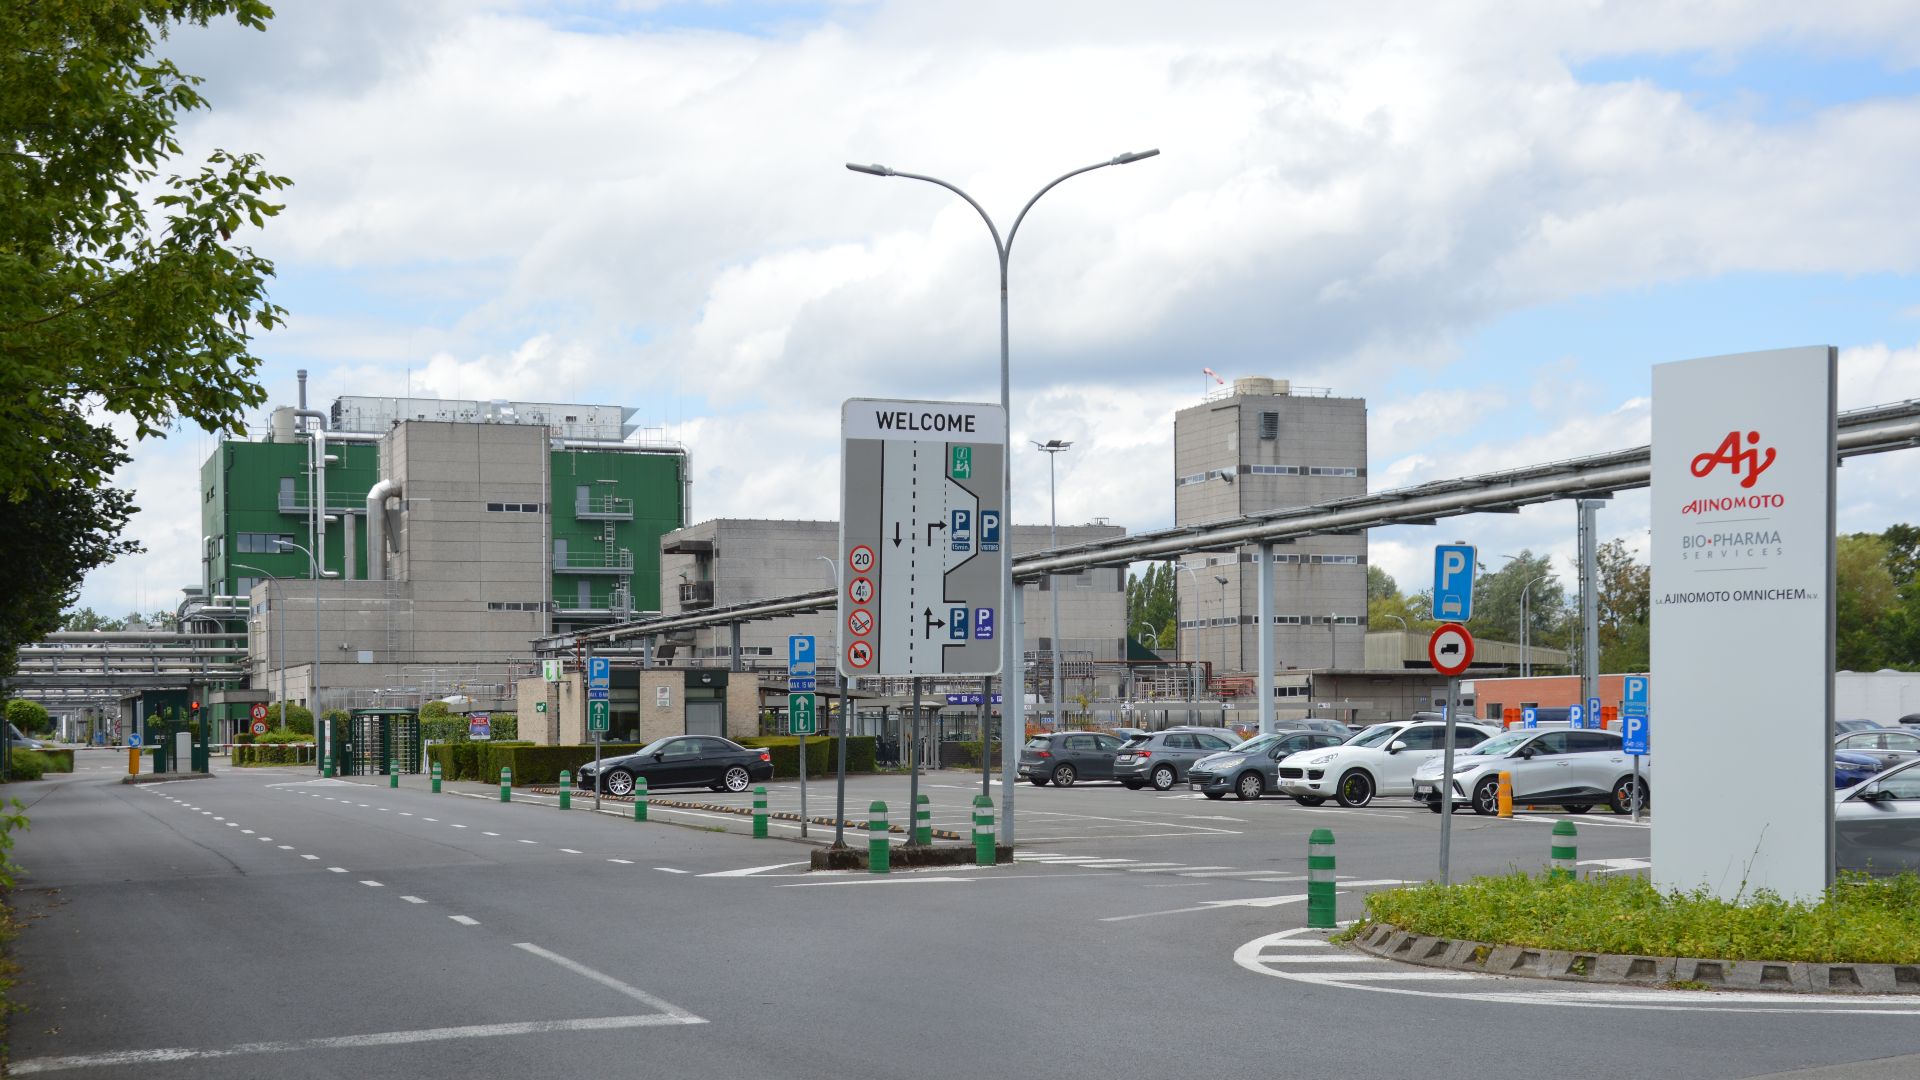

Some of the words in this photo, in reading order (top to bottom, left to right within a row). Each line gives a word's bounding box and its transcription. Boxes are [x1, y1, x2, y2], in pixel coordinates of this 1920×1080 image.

[876, 411, 976, 433] WELCOME
[1682, 494, 1784, 515] AJINOMOTO
[955, 512, 967, 529] P
[983, 515, 999, 538] P
[855, 553, 869, 565] 20
[1683, 548, 1783, 560] SERVICES
[1442, 551, 1466, 591] P
[1664, 591, 1730, 604] AJINOMOTO
[1733, 589, 1806, 602] OMNICHEM
[954, 610, 965, 627] P
[979, 609, 990, 625] P
[795, 638, 810, 660] P
[593, 660, 605, 677] P
[1629, 679, 1643, 700] P
[1525, 709, 1535, 728] P
[1571, 706, 1581, 728] P
[1590, 699, 1599, 722] P
[1628, 718, 1642, 739] P
